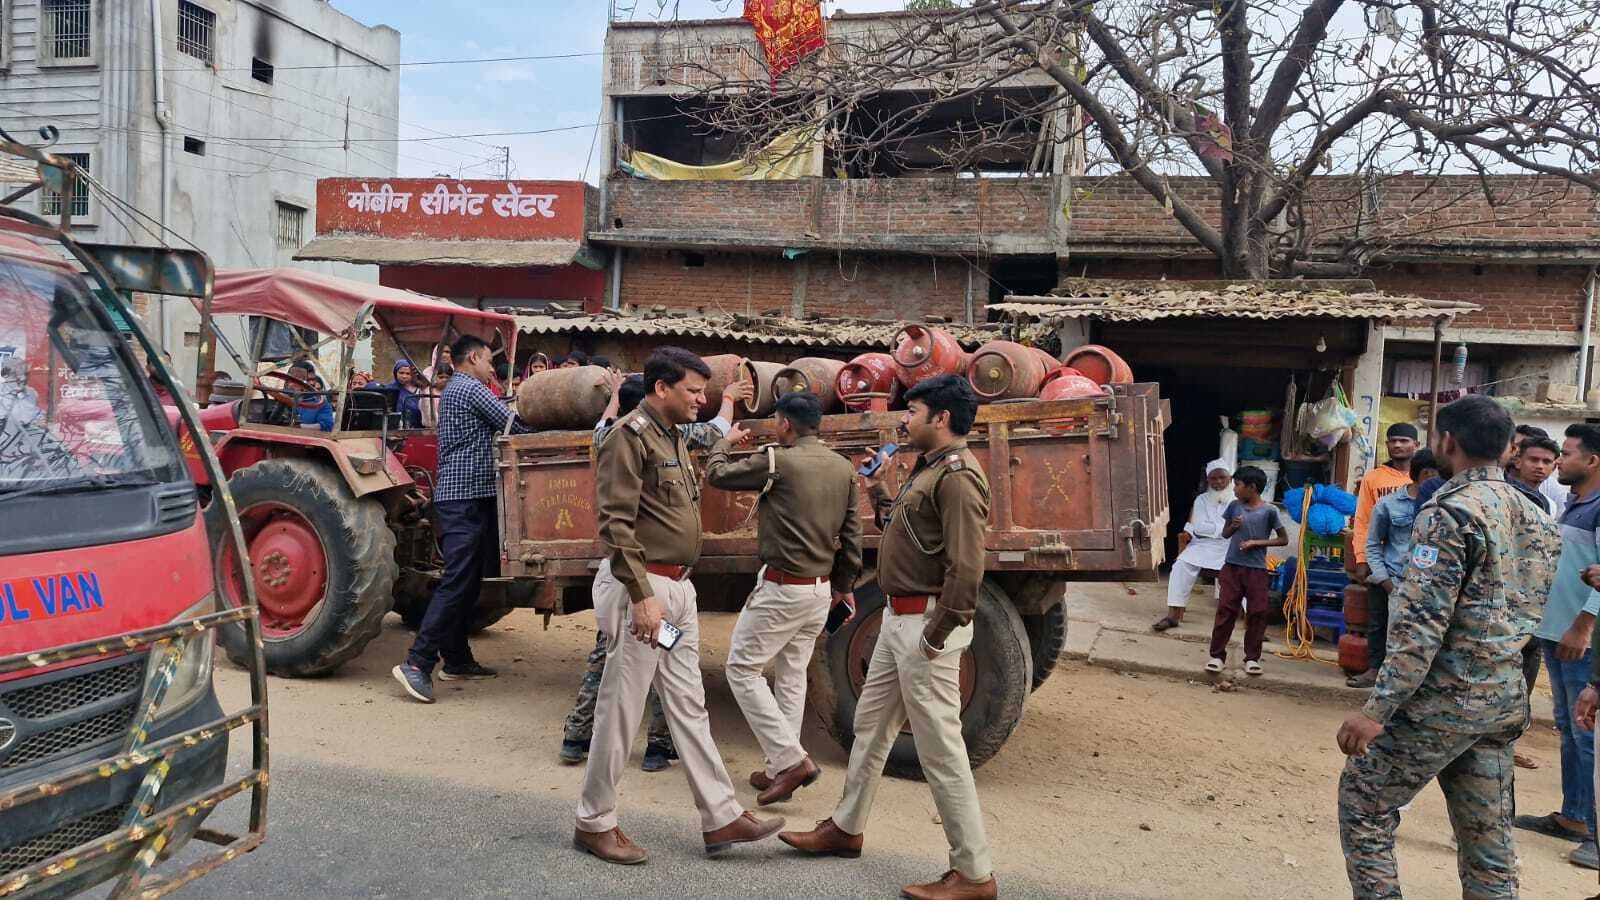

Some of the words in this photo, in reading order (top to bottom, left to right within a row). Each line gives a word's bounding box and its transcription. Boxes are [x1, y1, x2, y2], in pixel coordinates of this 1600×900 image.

[347, 183, 413, 214] मोबीन
[419, 183, 490, 216] सीमेंट
[491, 183, 559, 218] सेंटर
[32, 572, 105, 617] VAN
